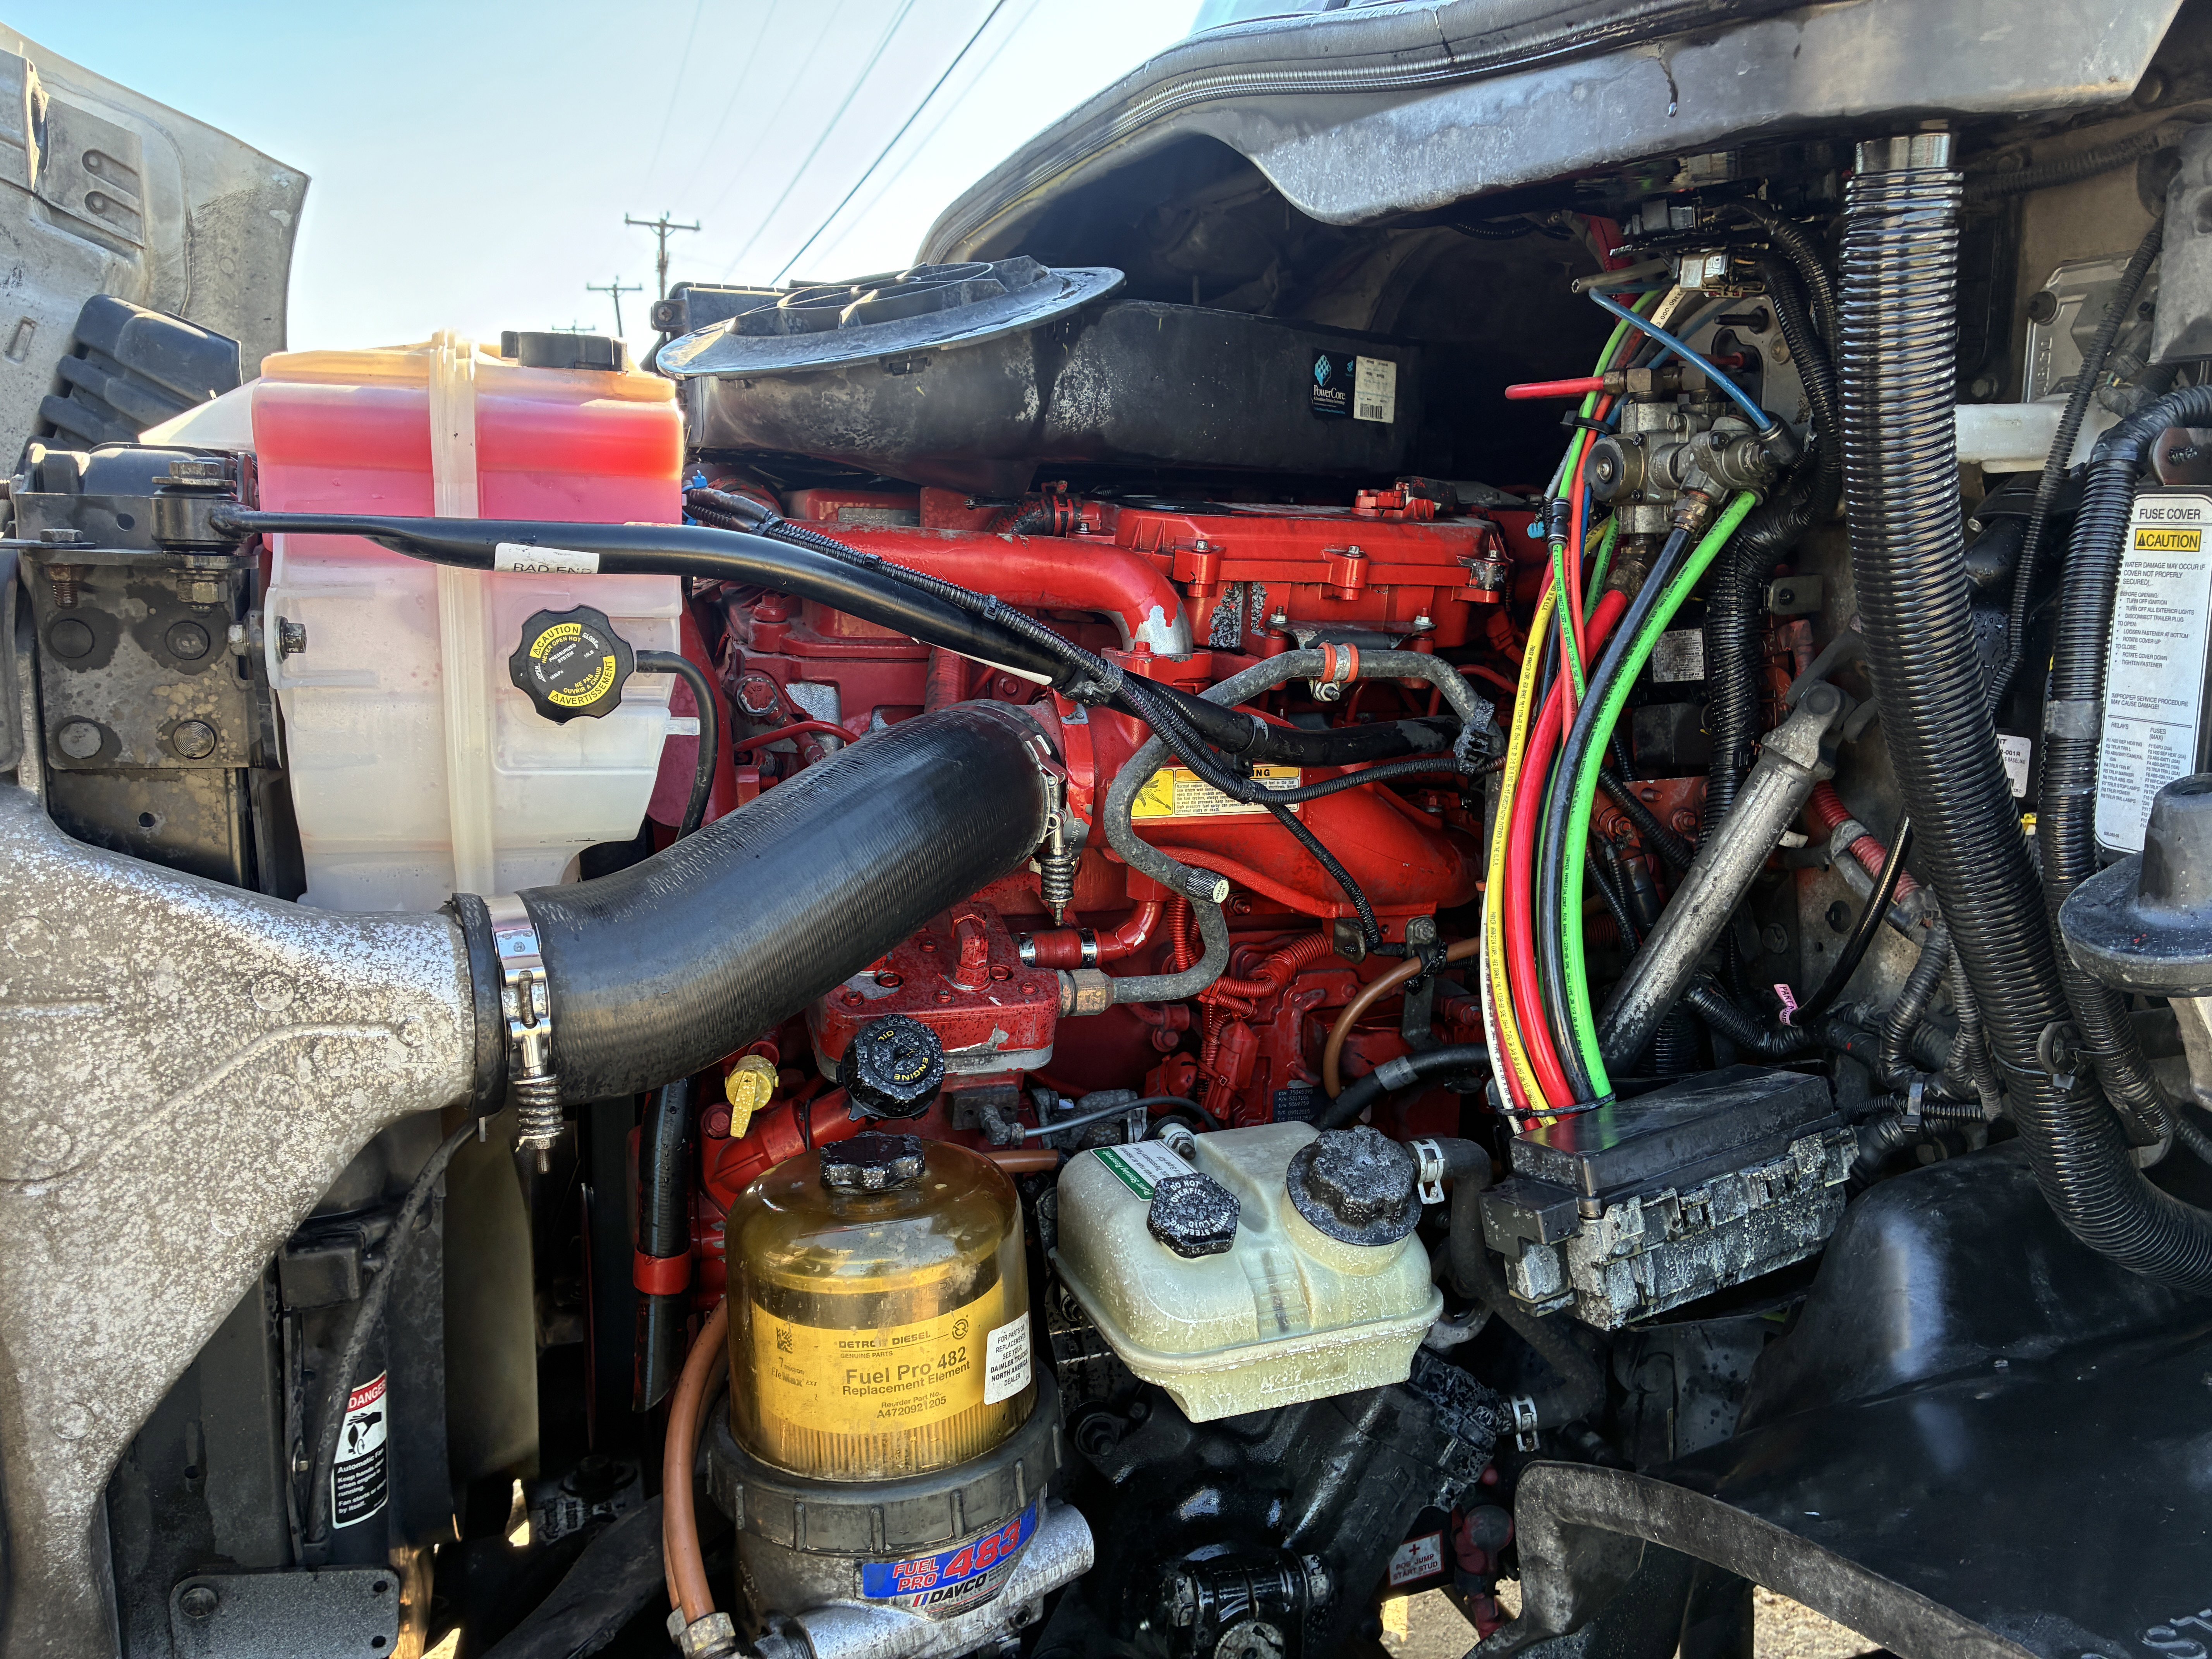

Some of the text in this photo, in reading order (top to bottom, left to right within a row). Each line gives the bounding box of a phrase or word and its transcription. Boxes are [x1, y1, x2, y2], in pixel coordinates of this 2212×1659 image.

[1314, 385, 1345, 400] PowerCore
[2140, 508, 2200, 520] FUSE COVER
[2147, 534, 2198, 548] CAUTION
[514, 563, 549, 572] RAD
[537, 626, 579, 647] CAUTION
[583, 632, 599, 644] CLOSE
[542, 645, 553, 663] NEVER
[552, 636, 567, 646] OPEN
[549, 643, 577, 662] PRESSURIZED
[557, 651, 574, 663] SYSTEM
[534, 666, 543, 680] OPEN
[583, 674, 593, 683] PAS
[590, 666, 601, 685] CHAUD
[559, 661, 612, 704] AVERTISSEMENT
[2158, 698, 2188, 707] PROCEDURE
[878, 1030, 894, 1041] OIL
[894, 1057, 929, 1081] ENGINE
[1103, 1151, 1123, 1168] Reservoir
[1120, 1167, 1140, 1183] Steering
[1136, 1182, 1153, 1195] Power
[1170, 1182, 1181, 1191] DO
[1171, 1188, 1206, 1202] OVERFILL
[1170, 1211, 1229, 1236] POWER STEERING
[1188, 1217, 1216, 1228] FLUID
[892, 1331, 931, 1345] DIESEL
[996, 1332, 1026, 1353] REPLACEMENTS
[998, 1334, 1007, 1344] FOR
[1008, 1328, 1020, 1340] PARTS
[991, 1348, 1028, 1373] DAIMLER TRUCKS
[1003, 1345, 1022, 1360] SEE YOUR
[778, 1357, 804, 1375] 7 micron
[846, 1346, 967, 1384] Fuel Pro 482
[991, 1358, 1028, 1382] NORTH AMERICA
[843, 1360, 970, 1396] Replacement Element
[1005, 1373, 1020, 1386] DEALER
[349, 1379, 386, 1409] DANGER
[877, 1396, 946, 1418] A4720921205
[882, 1399, 911, 1408] Reorder
[337, 1448, 384, 1474] Automatic Fan
[337, 1466, 374, 1482] Keep hands
[337, 1472, 376, 1490] when engine
[338, 1486, 366, 1497] running.
[338, 1498, 351, 1506] Fan
[352, 1491, 370, 1503] starts
[339, 1506, 347, 1515] by
[943, 1518, 1021, 1580] 483
[893, 1558, 939, 1578] FUEL
[1393, 1568, 1417, 1580] START
[1419, 1561, 1437, 1572] STUD
[1396, 1561, 1411, 1571] POS
[1415, 1554, 1434, 1565] JUMP
[897, 1573, 938, 1592] PRO
[929, 1573, 987, 1604] DAVCO
